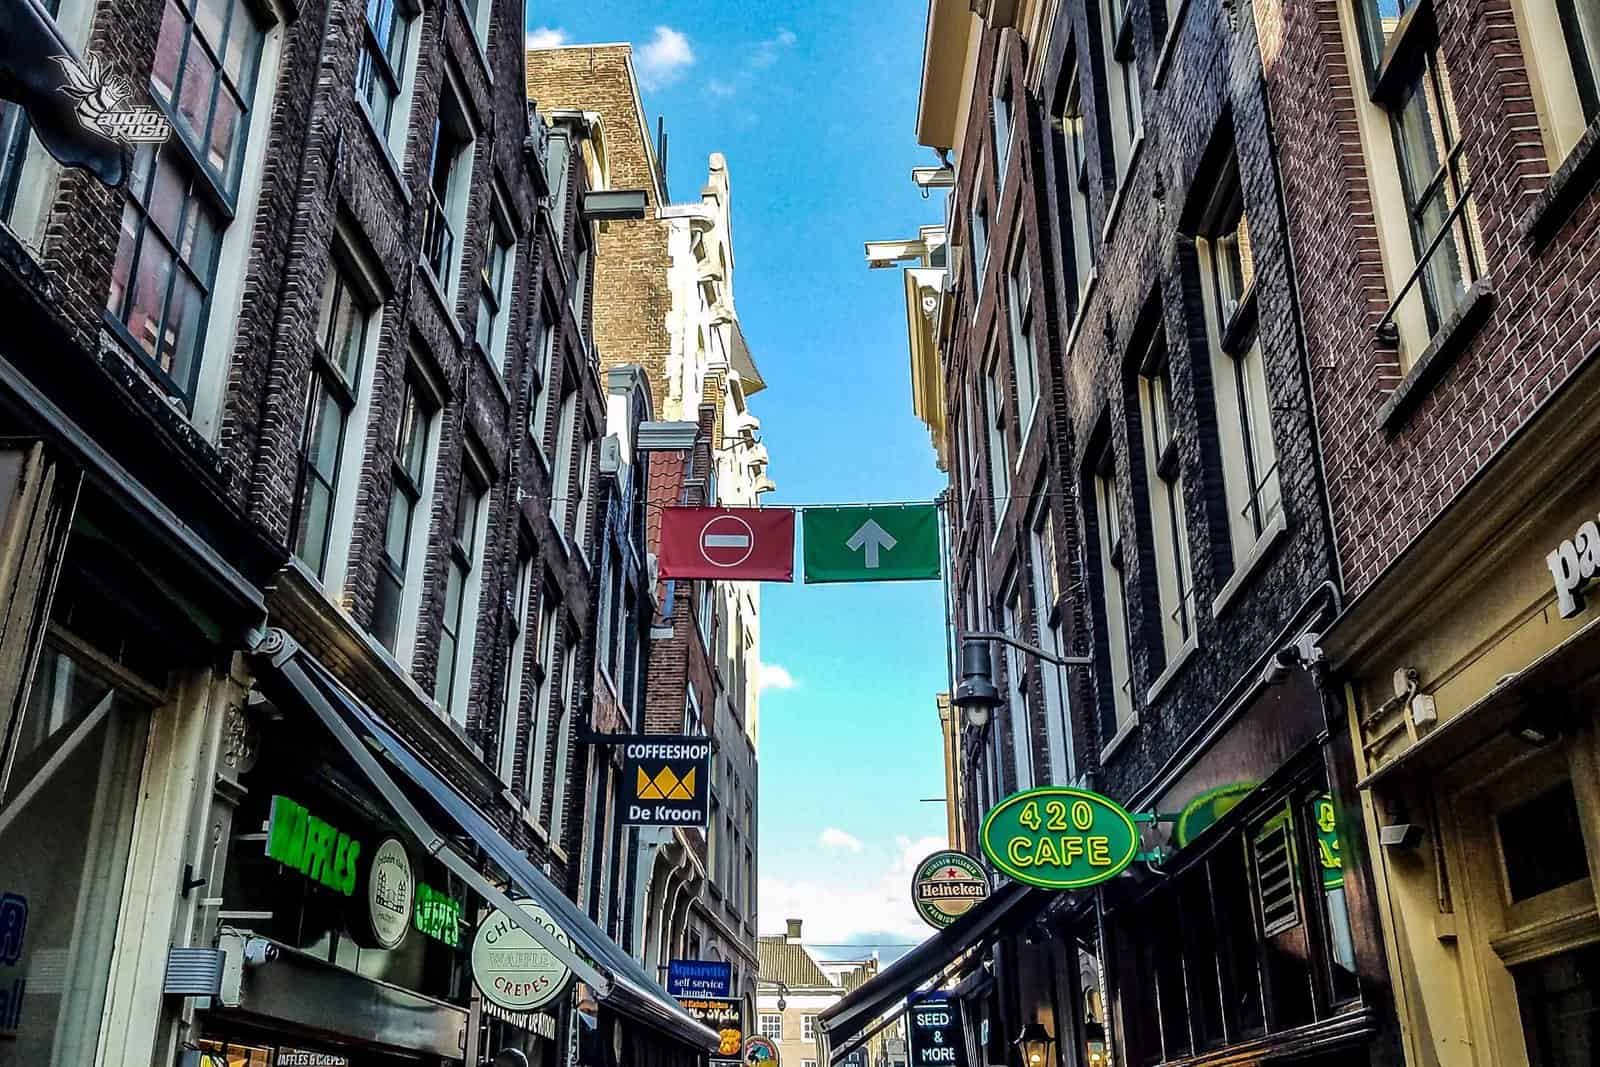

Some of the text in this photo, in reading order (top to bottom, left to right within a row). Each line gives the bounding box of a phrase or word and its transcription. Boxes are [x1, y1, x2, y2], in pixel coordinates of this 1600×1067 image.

[1545, 512, 1600, 619] pa
[627, 743, 709, 760] COFFEESHOP
[629, 804, 702, 821] De Kroon
[1019, 800, 1093, 831] 420
[1007, 836, 1112, 867] CAFE
[922, 883, 985, 897] Heineken
[494, 975, 550, 997] CREPES
[674, 978, 724, 989] self service
[916, 1012, 950, 1026] SEED
[933, 1030, 944, 1043] &
[921, 1047, 956, 1061] MORE
